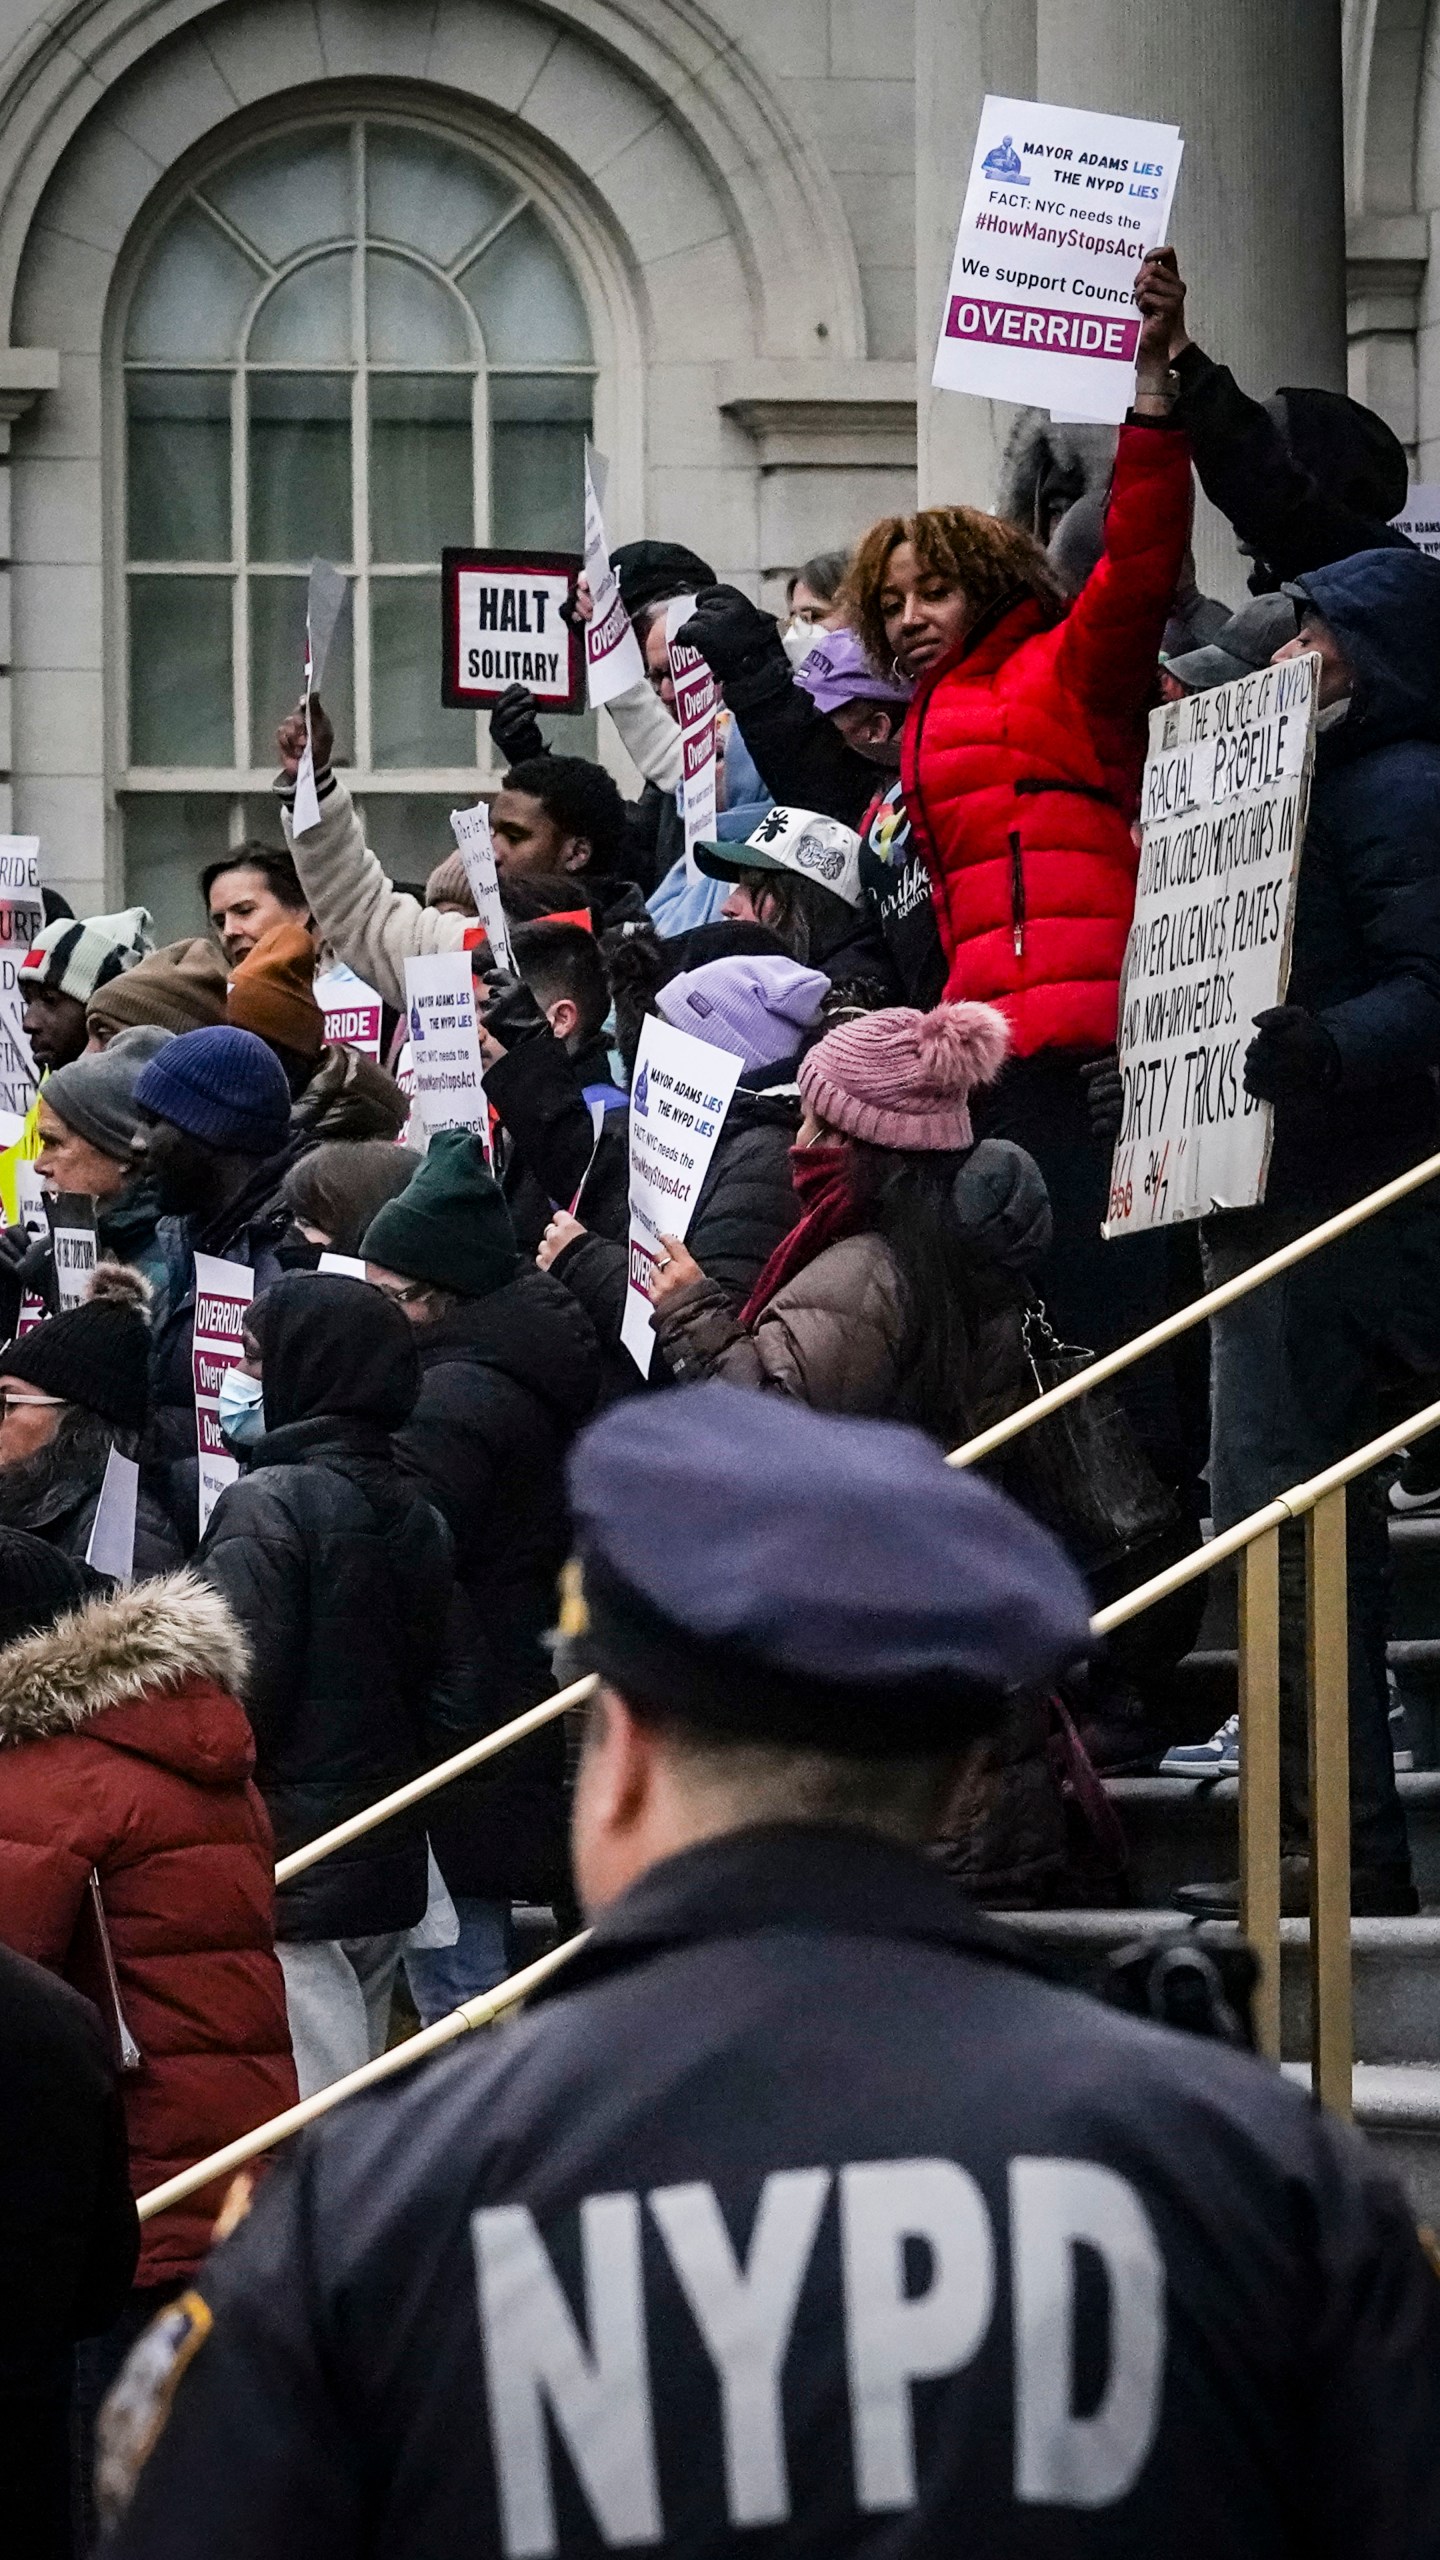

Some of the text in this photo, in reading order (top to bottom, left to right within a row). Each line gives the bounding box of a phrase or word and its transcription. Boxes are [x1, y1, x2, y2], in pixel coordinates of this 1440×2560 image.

[1023, 142, 1164, 177] MAYOR ADAMS LIES
[1054, 169, 1159, 200] THE NYPD LIES
[989, 191, 1141, 231] FACT: NYC needs the
[975, 212, 1145, 260] #HowManyStopsAct
[961, 257, 1138, 307] We support Counci
[957, 303, 1126, 353] OVERRIDE
[479, 587, 550, 634] HALT
[468, 649, 559, 682] SOLITARY
[1190, 697, 1210, 742] THE
[1257, 672, 1273, 718] OF
[1148, 715, 1289, 817] RACIAL PROFILE
[1279, 795, 1297, 853] IN
[1129, 914, 1169, 980] RIVER
[1232, 878, 1283, 952] PLATES
[456, 992, 470, 1005] LIES
[325, 1011, 371, 1039] RRIDE
[429, 1014, 473, 1030] THE NYPD LIES
[458, 1048, 469, 1061] the
[650, 1068, 723, 1113] MAYOR ADAMS LIES
[1118, 1039, 1240, 1147] DIRTY TRICKS
[658, 1099, 715, 1138] THE NYPD LIES
[657, 1143, 679, 1162] needs
[679, 1152, 695, 1169] the
[632, 1248, 651, 1290] OVER
[470, 2156, 1167, 2558] NYPD
